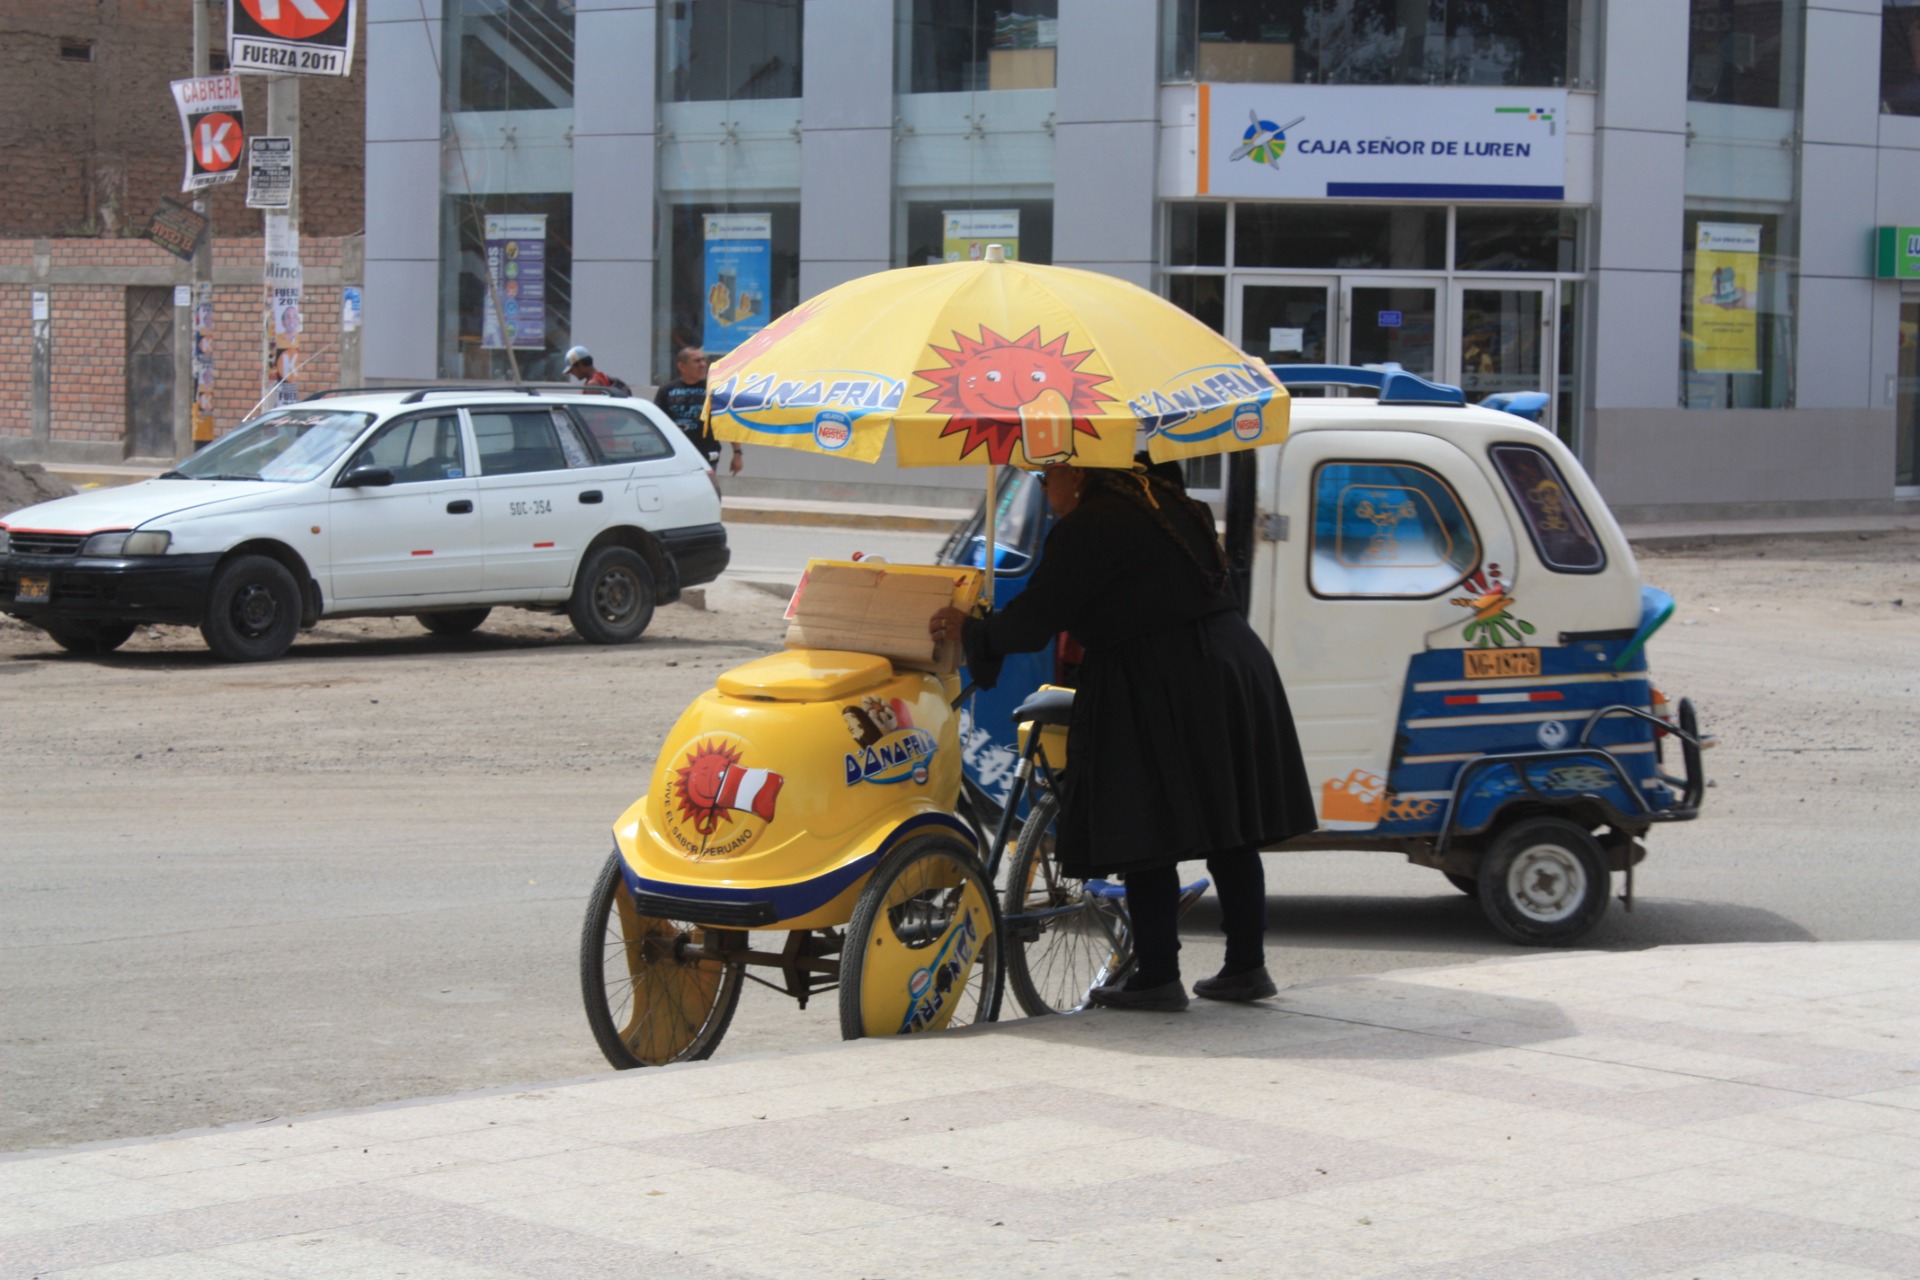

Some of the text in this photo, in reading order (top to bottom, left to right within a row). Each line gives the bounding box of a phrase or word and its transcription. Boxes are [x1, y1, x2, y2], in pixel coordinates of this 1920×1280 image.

[242, 45, 337, 71] FUERZA 2011
[182, 76, 241, 104] CABRERA
[201, 122, 233, 164] K
[1297, 136, 1531, 157] CAJA SEÑOR DE LUREN
[664, 781, 753, 857] VIVE EL SABOR PERUANO
